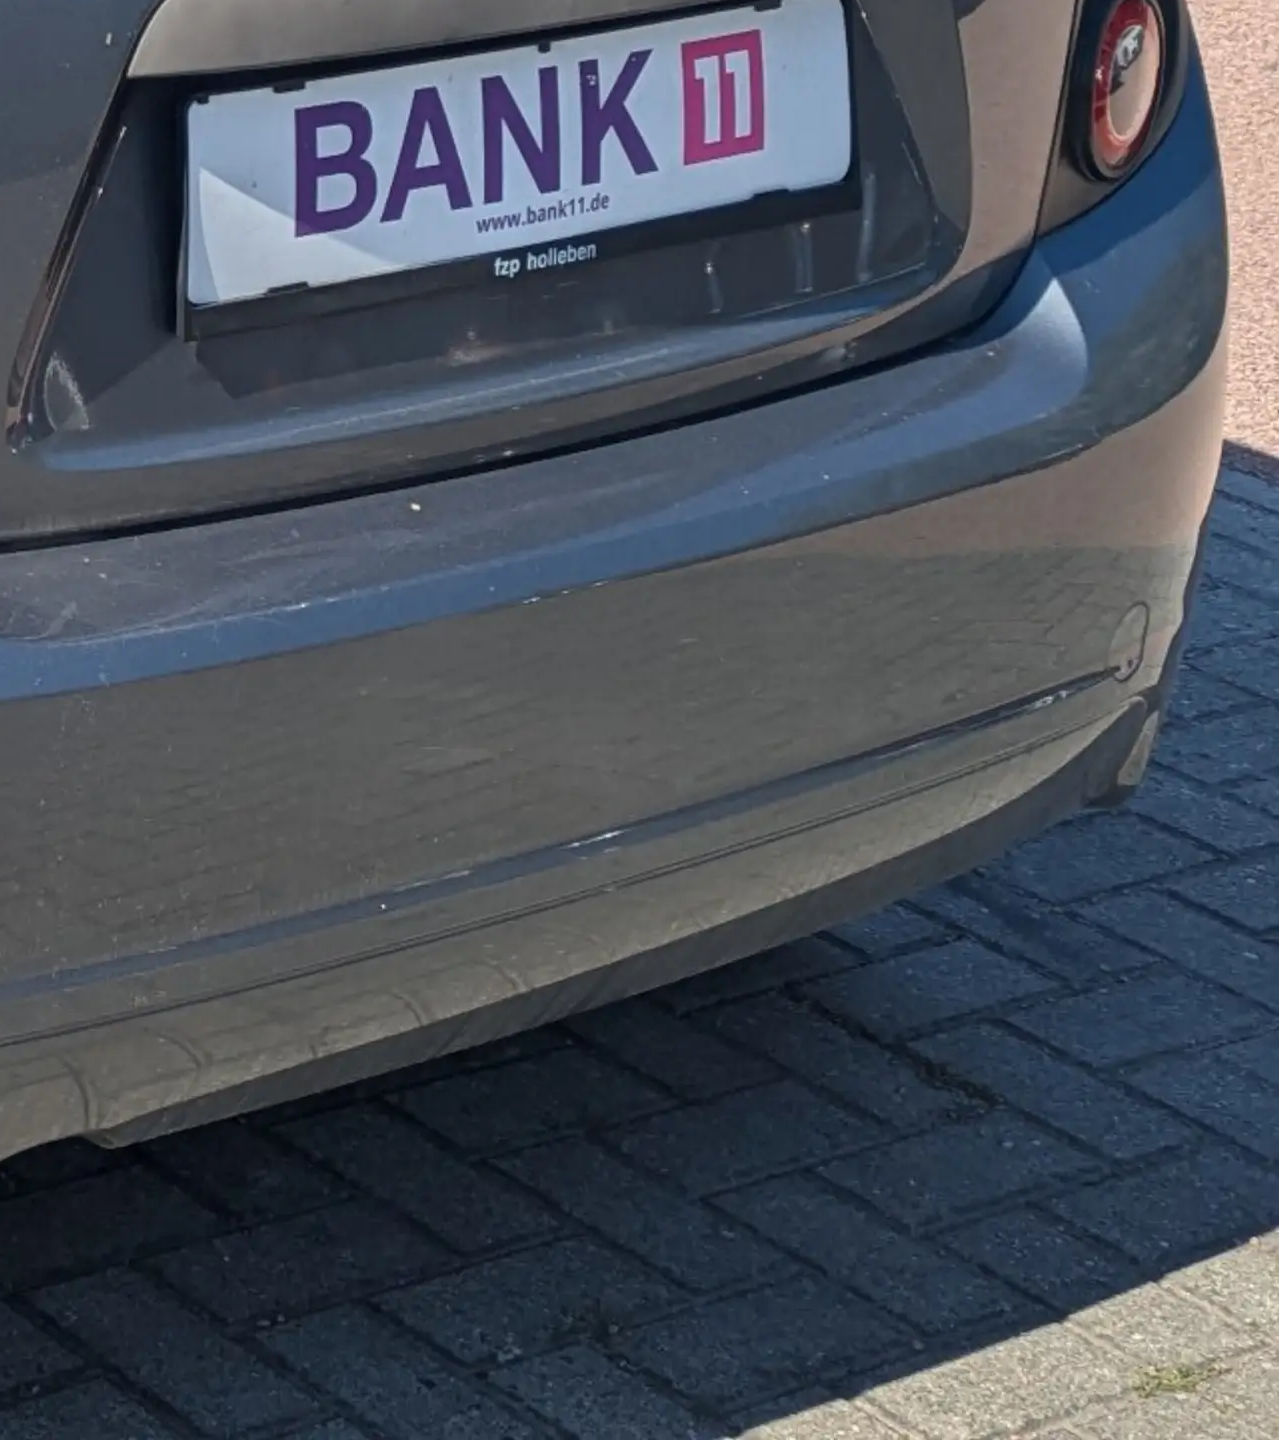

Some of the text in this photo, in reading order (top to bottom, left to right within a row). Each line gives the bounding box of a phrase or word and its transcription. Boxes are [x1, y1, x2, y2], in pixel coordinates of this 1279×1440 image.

[294, 42, 757, 238] BANK 11
[475, 192, 610, 234] www.bank11.de
[494, 244, 597, 279] fzp holleben
